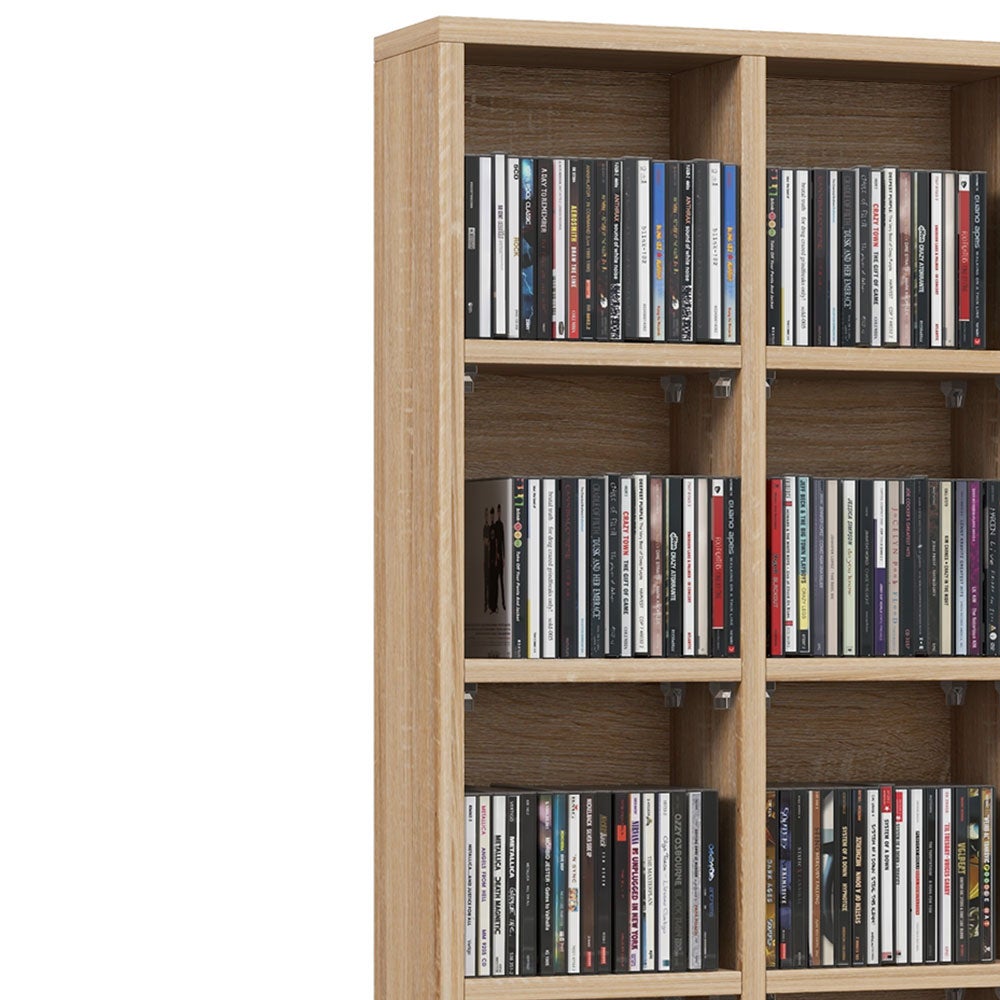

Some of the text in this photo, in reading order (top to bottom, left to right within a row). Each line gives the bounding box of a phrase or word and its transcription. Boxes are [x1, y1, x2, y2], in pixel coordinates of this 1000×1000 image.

[541, 188, 547, 198] TO
[873, 279, 879, 287] OF
[623, 588, 629, 596] OF
[632, 903, 639, 911] IN
